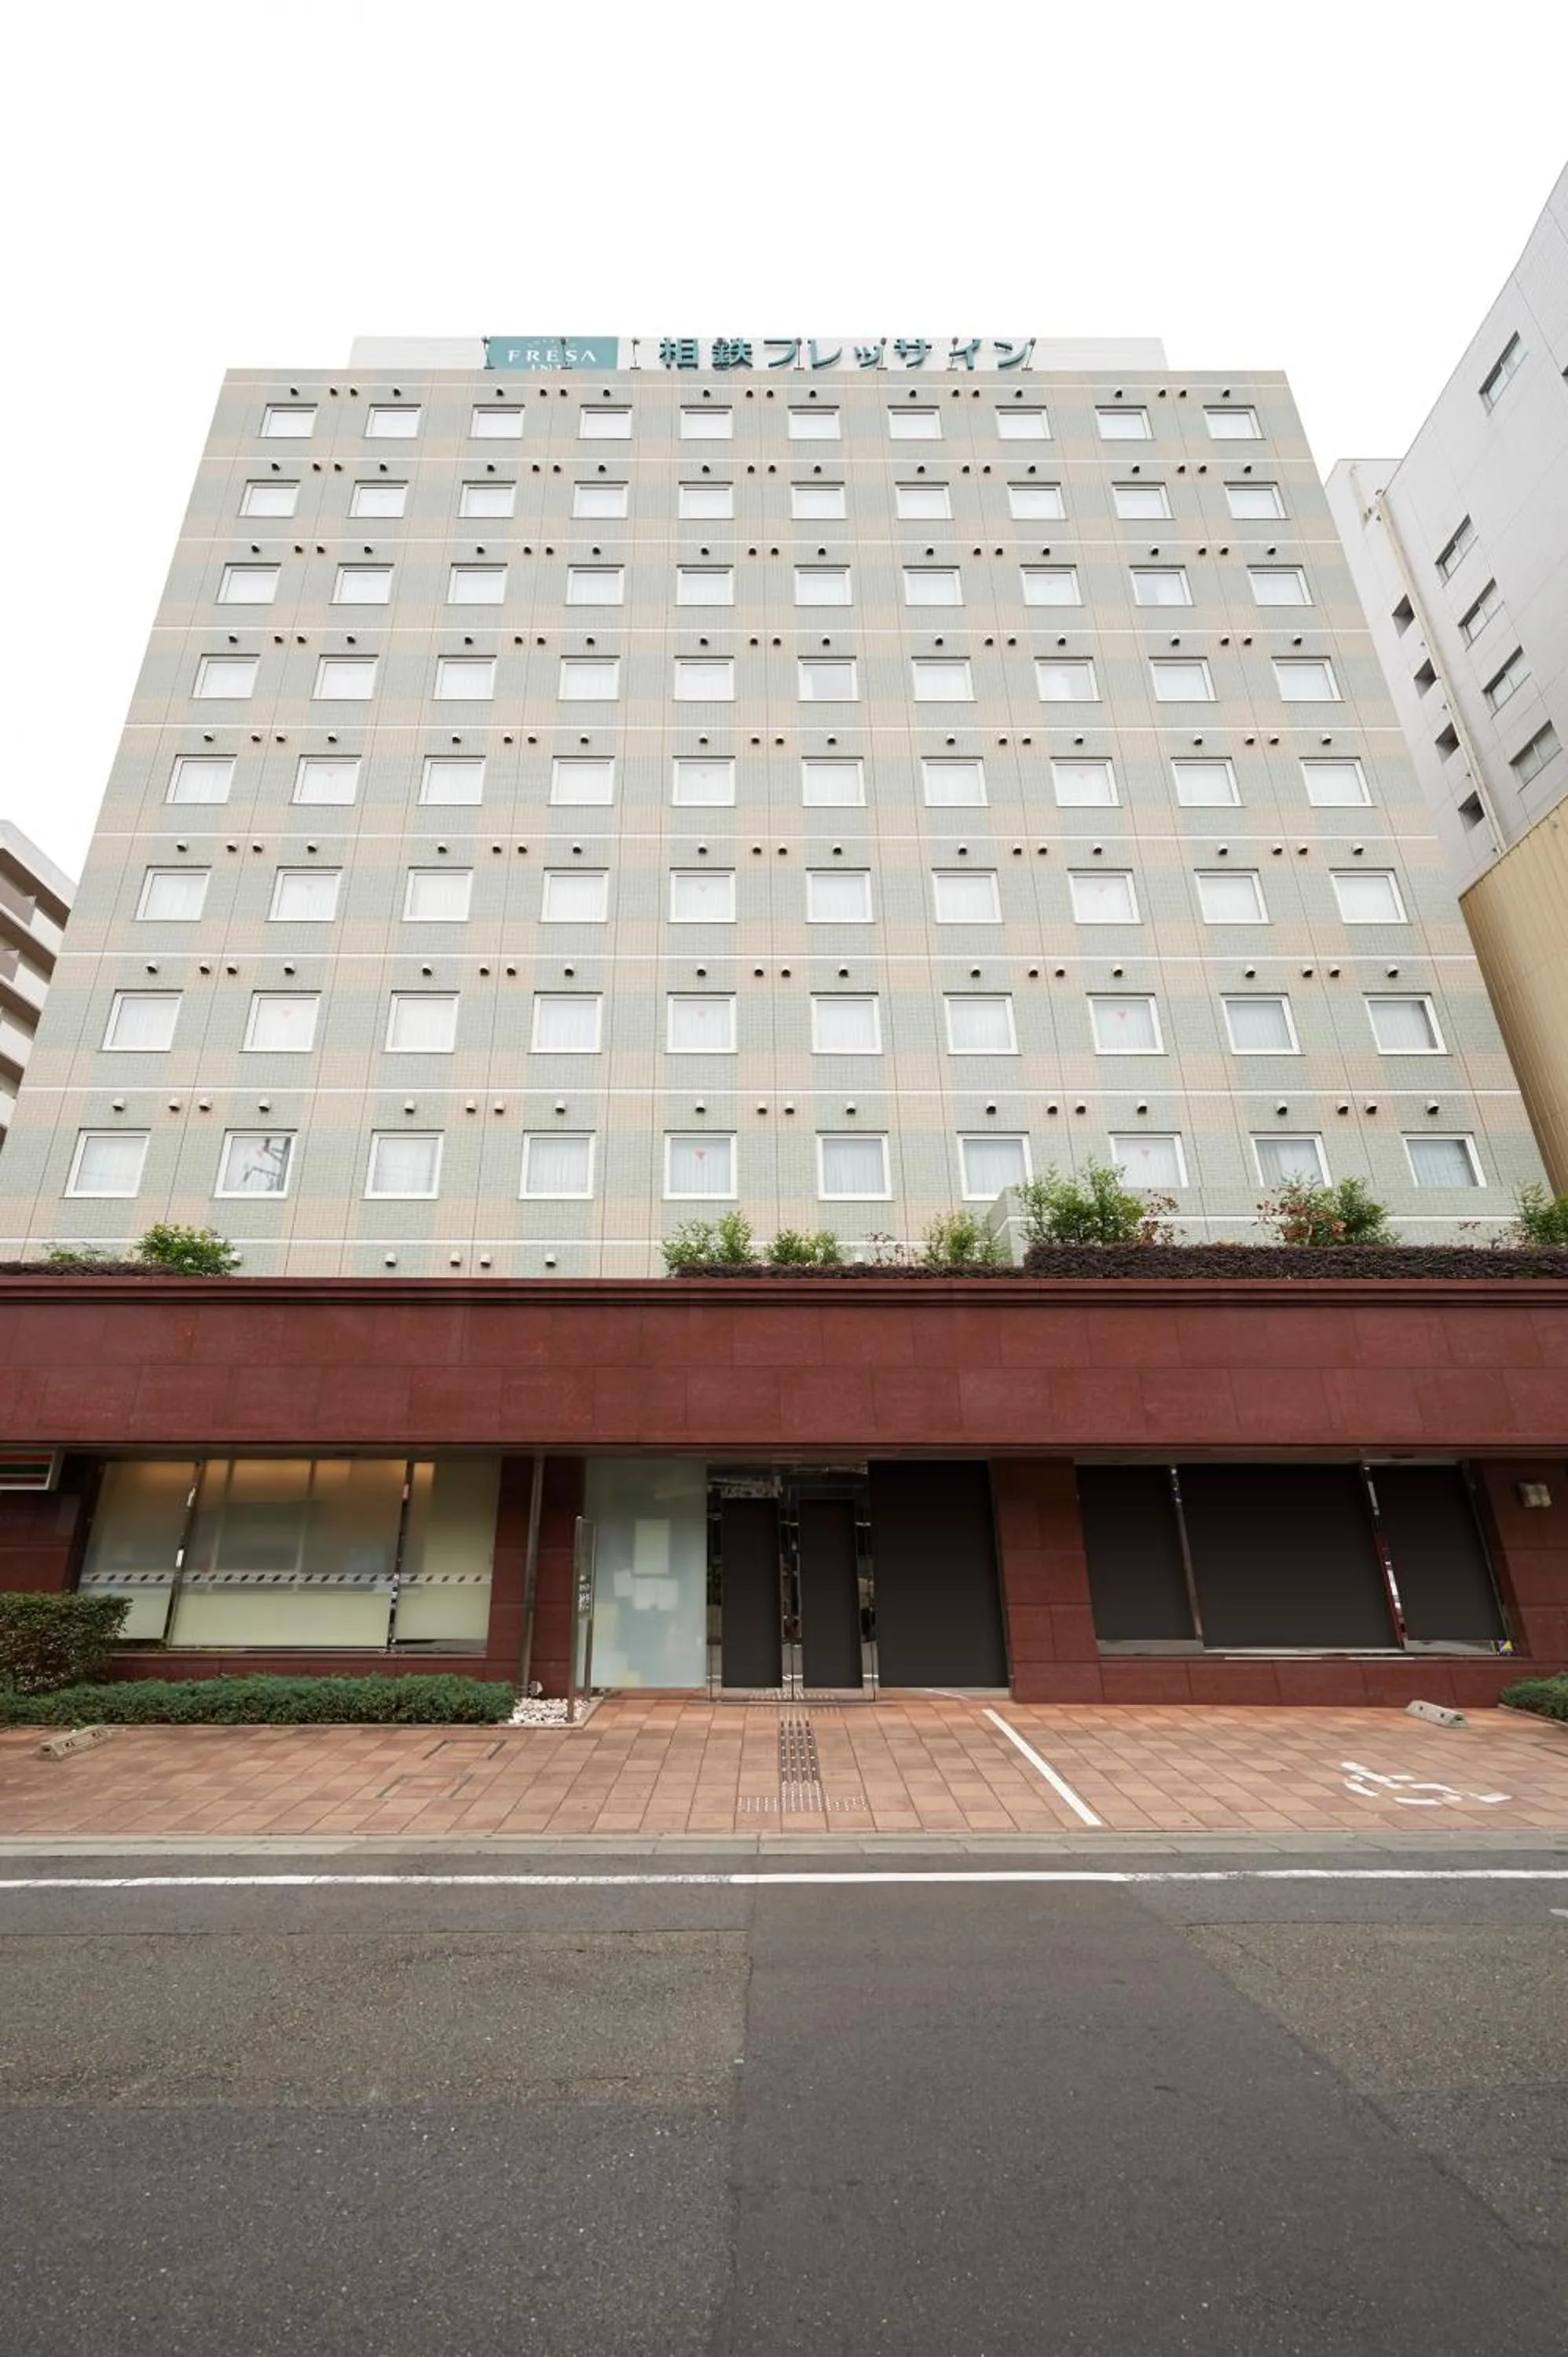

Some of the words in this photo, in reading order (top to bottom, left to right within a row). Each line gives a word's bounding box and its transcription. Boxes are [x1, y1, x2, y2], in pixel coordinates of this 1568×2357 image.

[659, 338, 1032, 369] 相鉄フレッサイン
